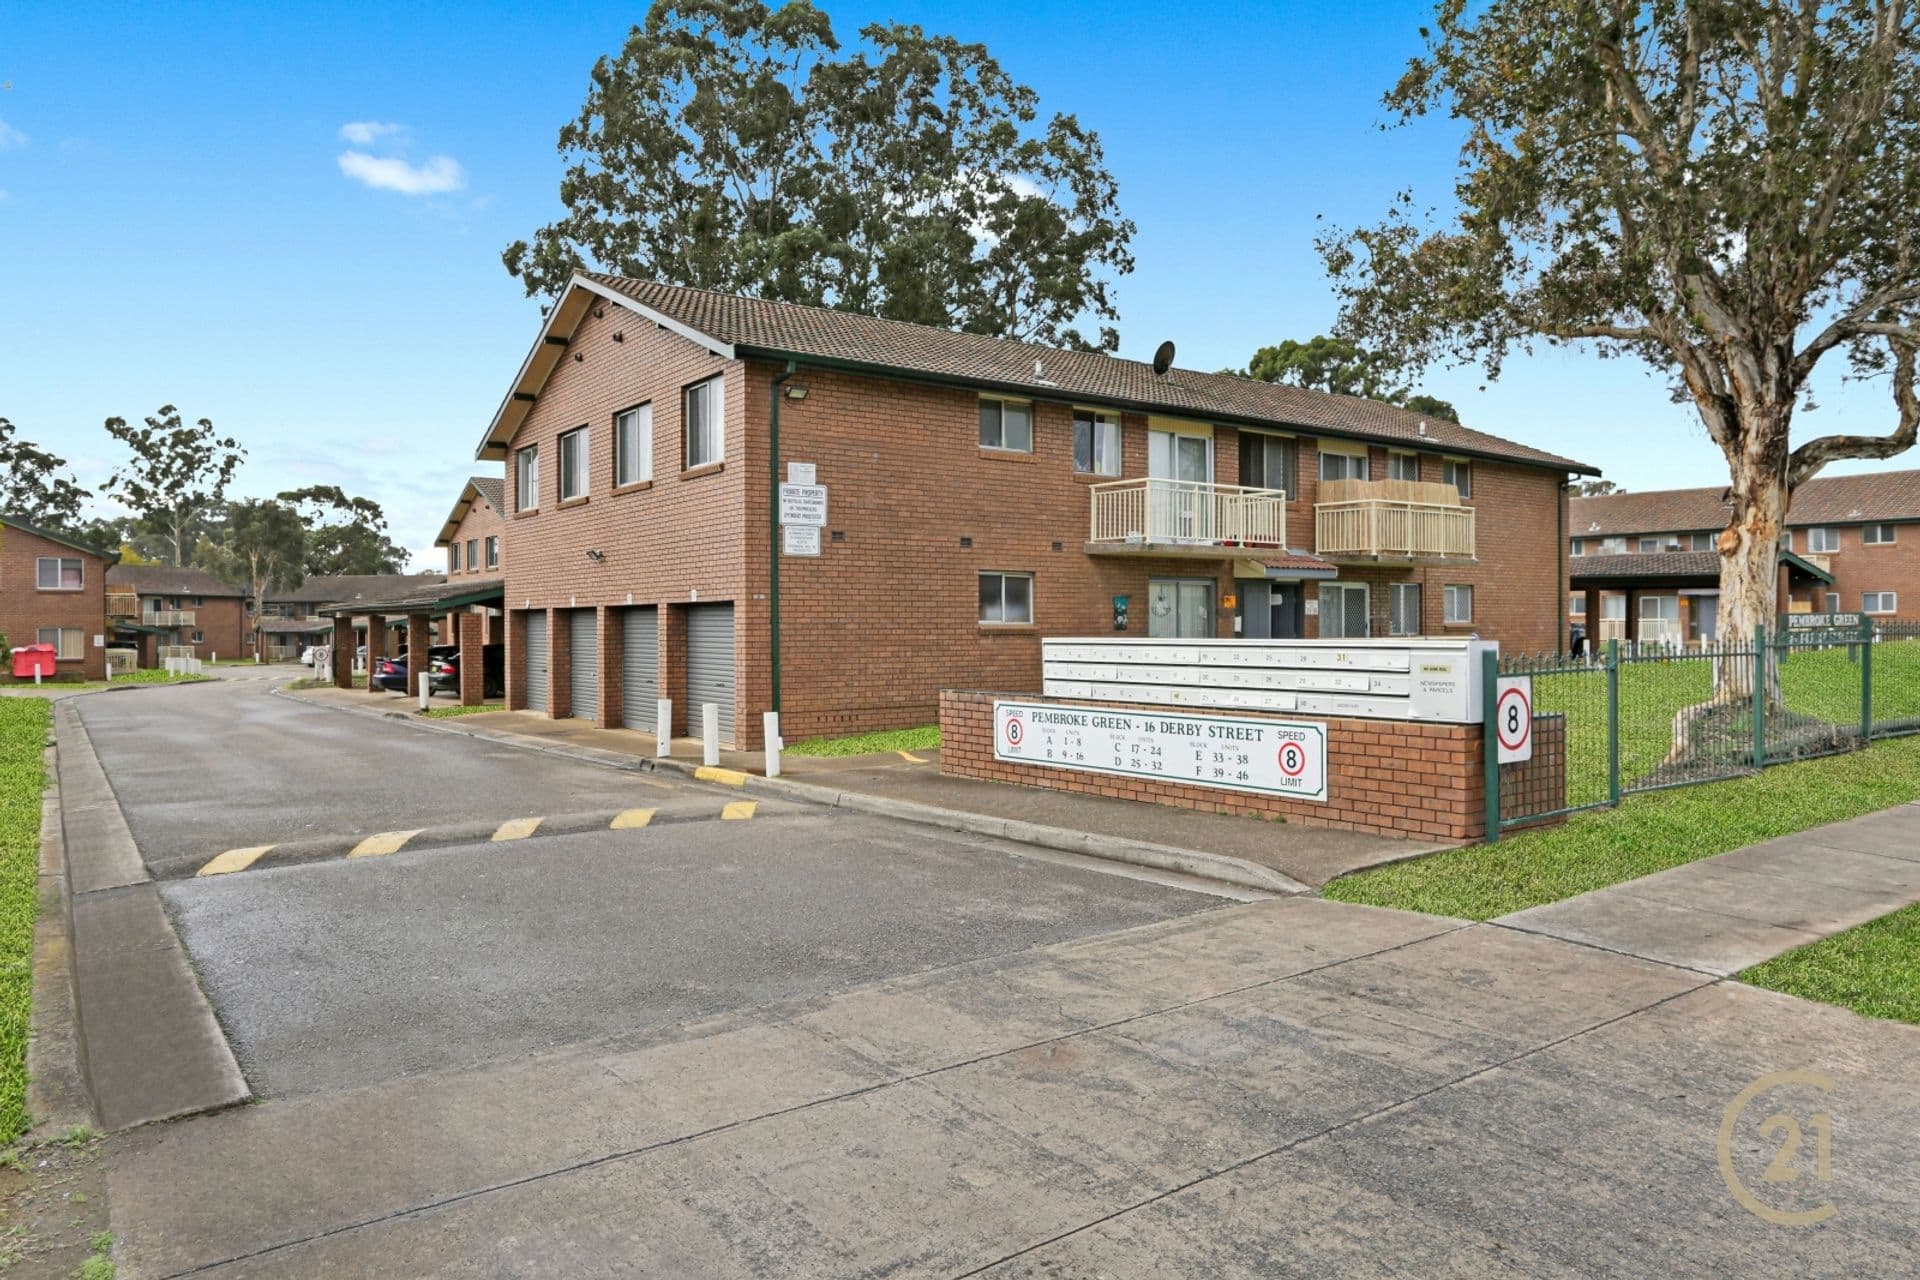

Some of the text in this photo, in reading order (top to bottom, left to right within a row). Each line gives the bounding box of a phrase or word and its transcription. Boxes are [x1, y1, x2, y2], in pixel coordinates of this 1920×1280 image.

[1788, 614, 1860, 627] PEMBROKE GREEN
[1336, 653, 1346, 662] 31
[1006, 709, 1023, 718] SPEED
[1508, 705, 1519, 734] 8
[1011, 724, 1018, 739] 8
[1032, 711, 1088, 726] PEMBROKE
[1092, 716, 1132, 730] GREEN
[1145, 721, 1155, 732] 16
[1160, 722, 1202, 736] DERBY
[1208, 726, 1264, 741] STREET
[1046, 736, 1052, 745] A
[1076, 738, 1081, 746] 8
[1278, 730, 1306, 741] SPEED
[1047, 750, 1052, 758] B
[1062, 750, 1067, 758] 9
[1114, 743, 1121, 752] C
[1131, 744, 1140, 754] 17
[1150, 746, 1161, 756] 24
[1114, 757, 1122, 766] D
[1131, 759, 1141, 768] 25
[1152, 760, 1162, 770] 32
[1196, 750, 1202, 761] E
[1213, 752, 1224, 762] 33
[1236, 754, 1248, 765] 38
[1286, 749, 1297, 769] 8
[1196, 766, 1202, 776] F
[1213, 768, 1224, 778] 39
[1236, 771, 1249, 781] 46
[1280, 777, 1303, 788] LIMIT
